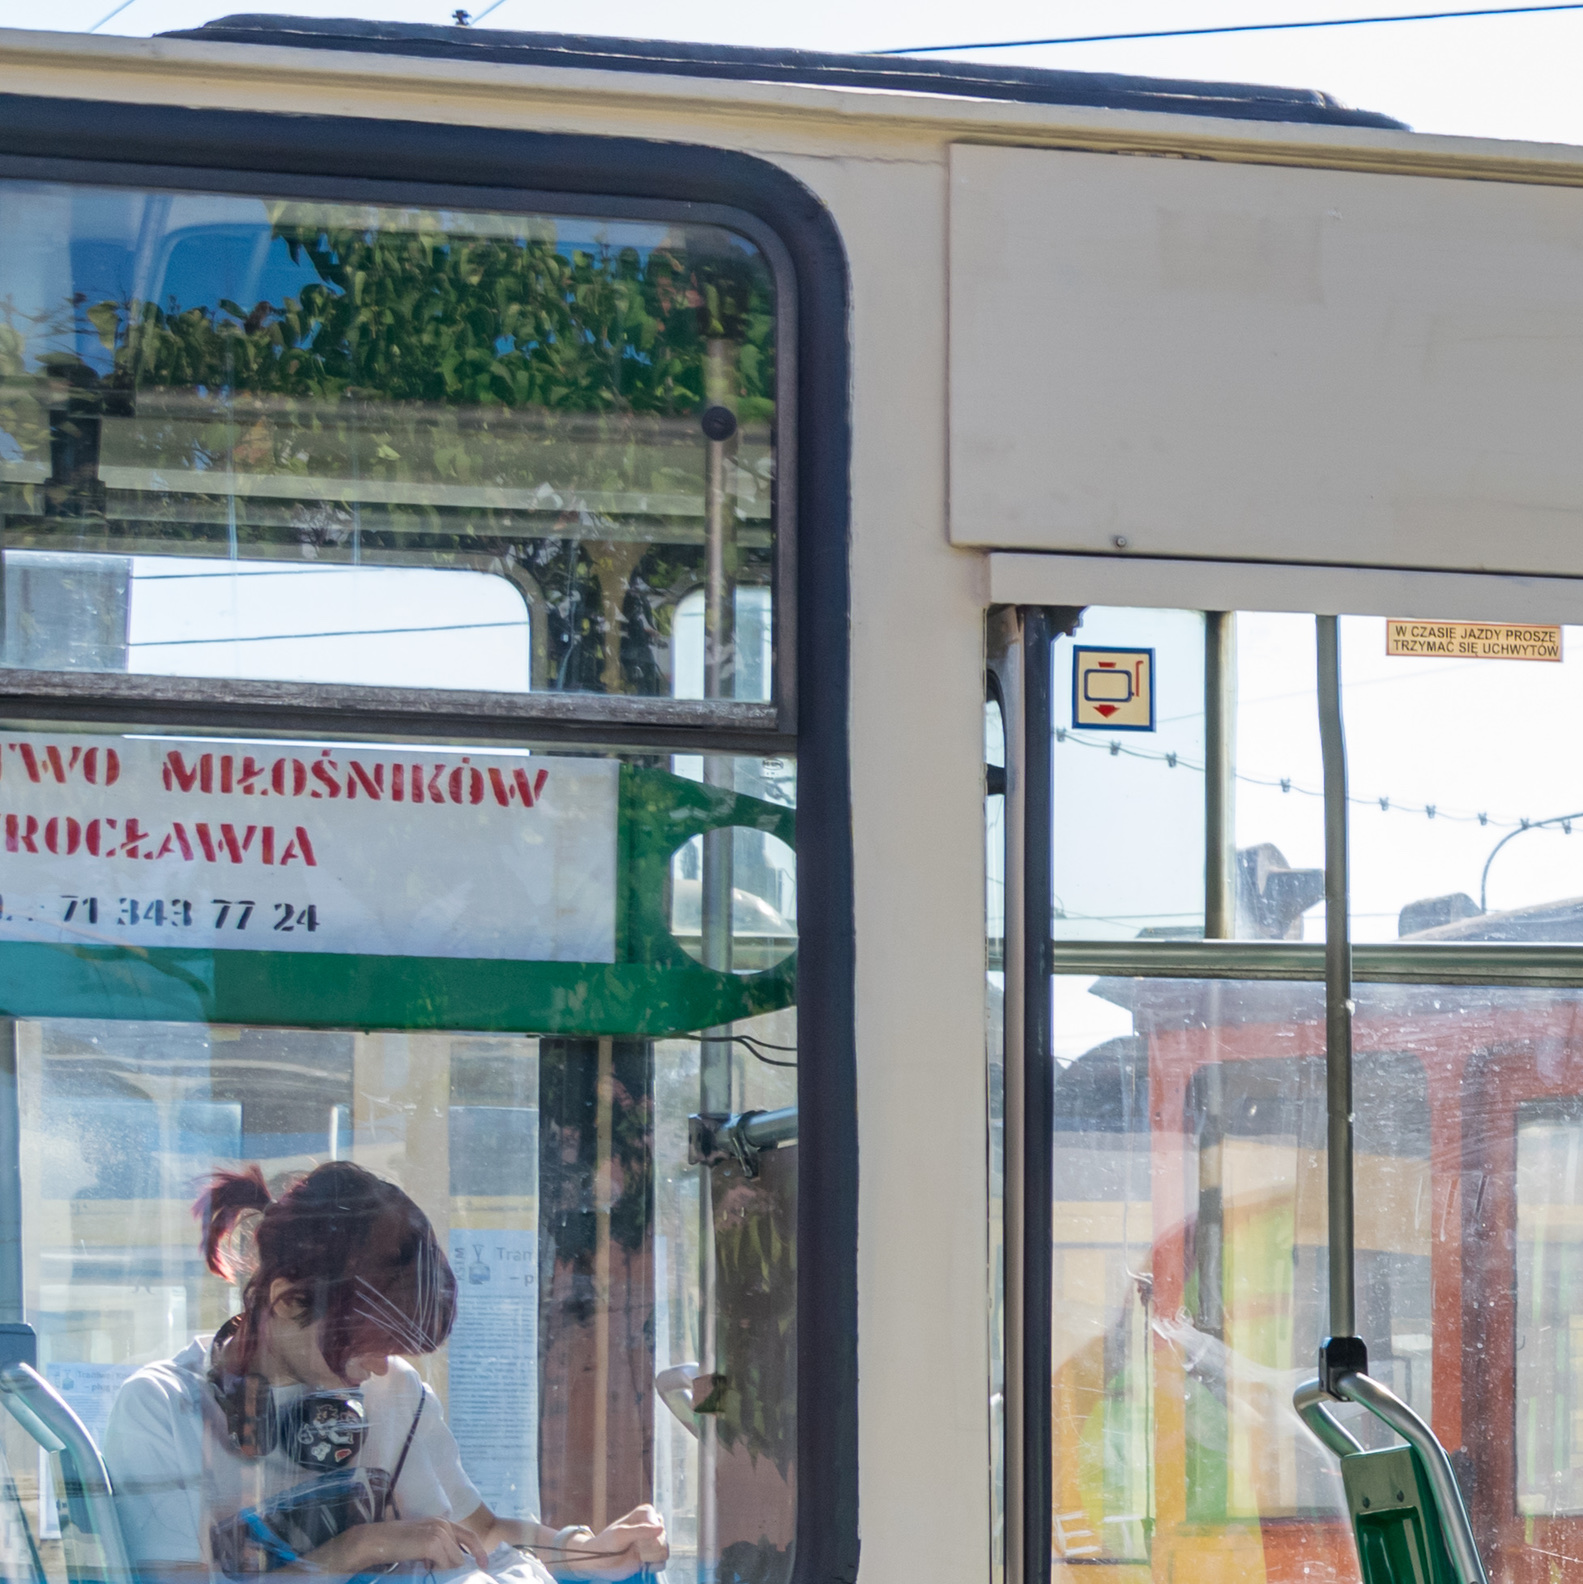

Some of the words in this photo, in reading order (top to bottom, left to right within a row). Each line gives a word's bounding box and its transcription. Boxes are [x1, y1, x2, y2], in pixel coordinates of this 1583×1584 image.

[1393, 638, 1455, 653] TRZYMAĆ
[1458, 642, 1479, 657] SIĘ
[1483, 642, 1559, 657] UCHWYTÓW
[1395, 626, 1407, 637] W
[1411, 626, 1456, 639] CZASIE
[1460, 628, 1502, 640] JAZDY
[0, 743, 120, 787] WO
[162, 749, 549, 808] MIŁOŚNIKÓW
[0, 813, 317, 867] ROCŁAWIA
[59, 895, 98, 924] 71
[118, 898, 192, 927] 343
[211, 899, 255, 929] 77
[274, 903, 320, 932] 24
